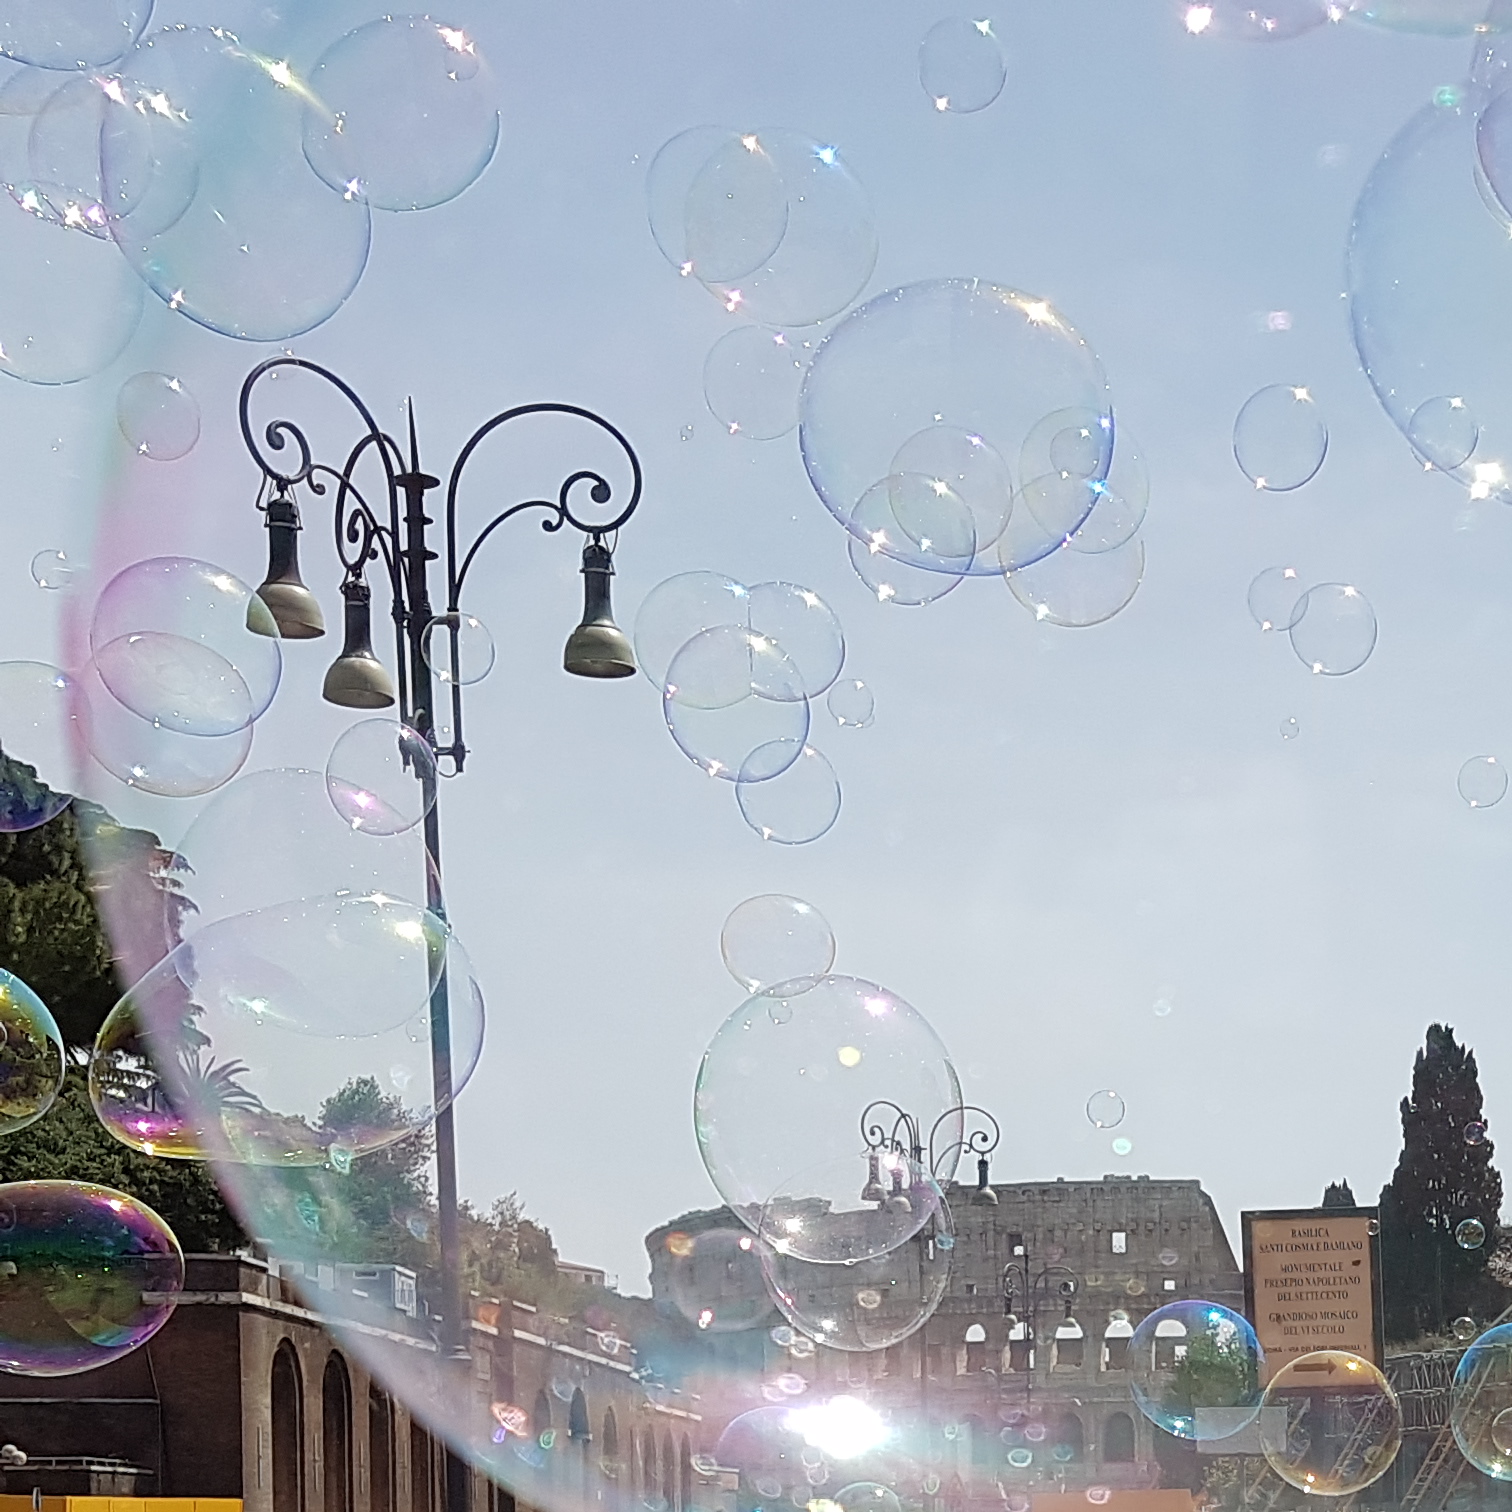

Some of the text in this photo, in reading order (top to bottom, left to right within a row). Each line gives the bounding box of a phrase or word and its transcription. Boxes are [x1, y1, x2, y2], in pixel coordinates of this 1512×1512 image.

[1291, 1227, 1330, 1238] BASILICA
[1259, 1243, 1284, 1253] SANTI
[1285, 1242, 1315, 1252] COSMA
[1323, 1240, 1363, 1251] DAMIANO
[1280, 1261, 1344, 1273] MONUMENTALE
[1264, 1275, 1361, 1288] PRESEPIO NAPOLETANO
[1277, 1290, 1349, 1302] DEL SETTECENTO
[1268, 1309, 1359, 1323] GRANDIOSO MOSAICO
[1283, 1324, 1345, 1336] DEL VI SECOLO
